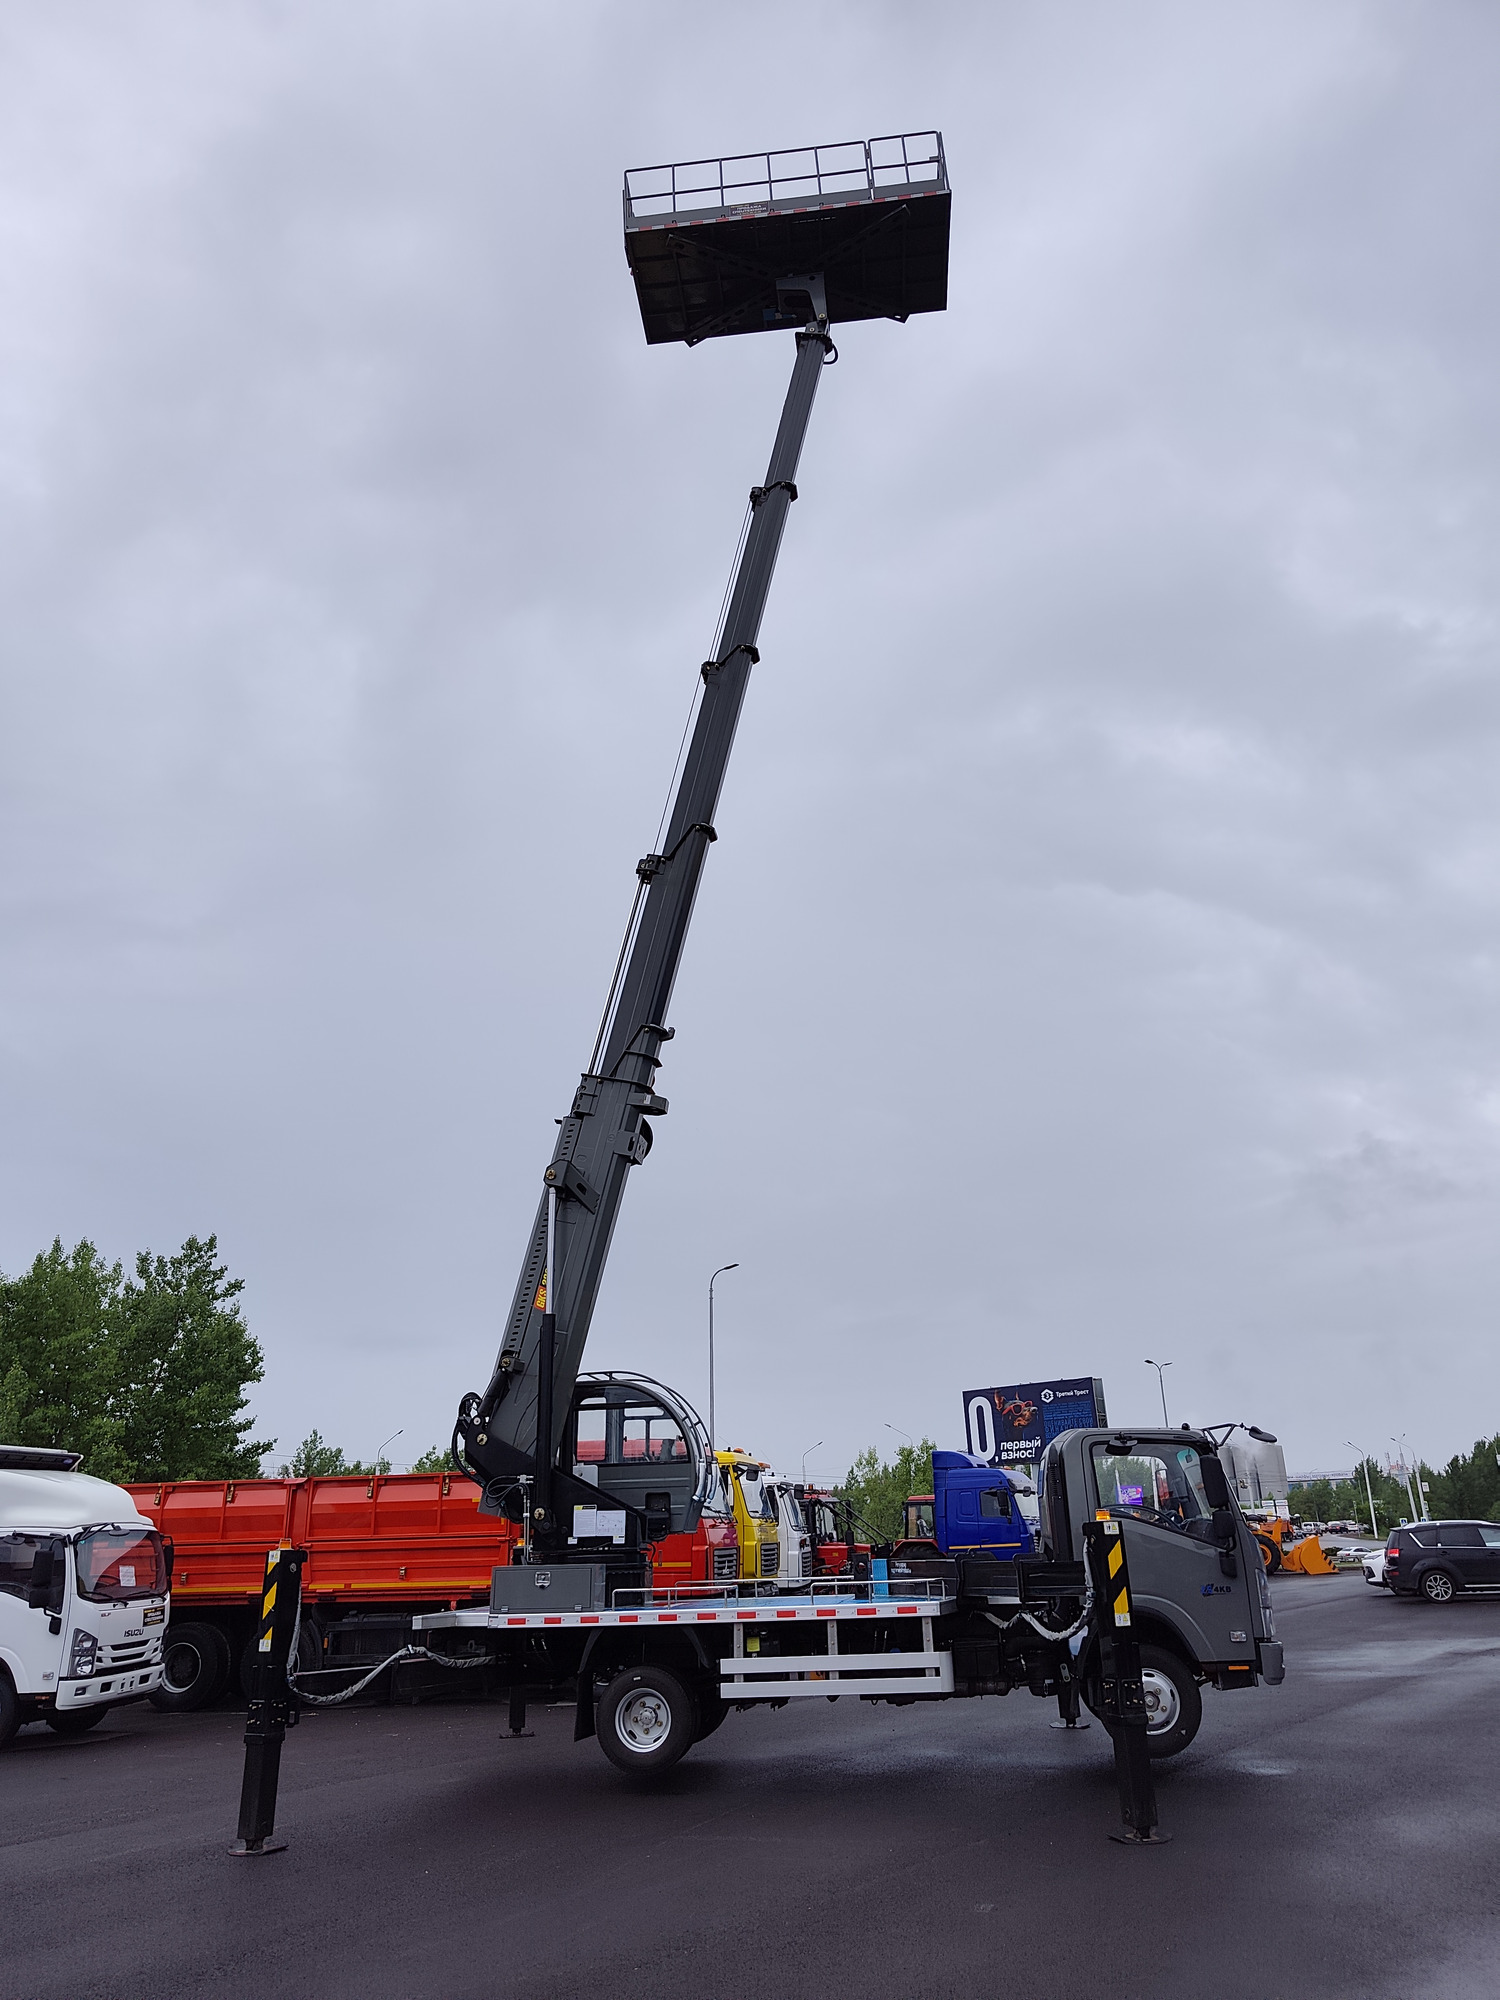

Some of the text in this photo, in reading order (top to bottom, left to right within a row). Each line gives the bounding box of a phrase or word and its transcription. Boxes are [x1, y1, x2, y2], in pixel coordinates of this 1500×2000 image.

[1000, 1436, 1041, 1452] первый
[1001, 1448, 1035, 1460] взнос!
[124, 1629, 144, 1637] ISUZU
